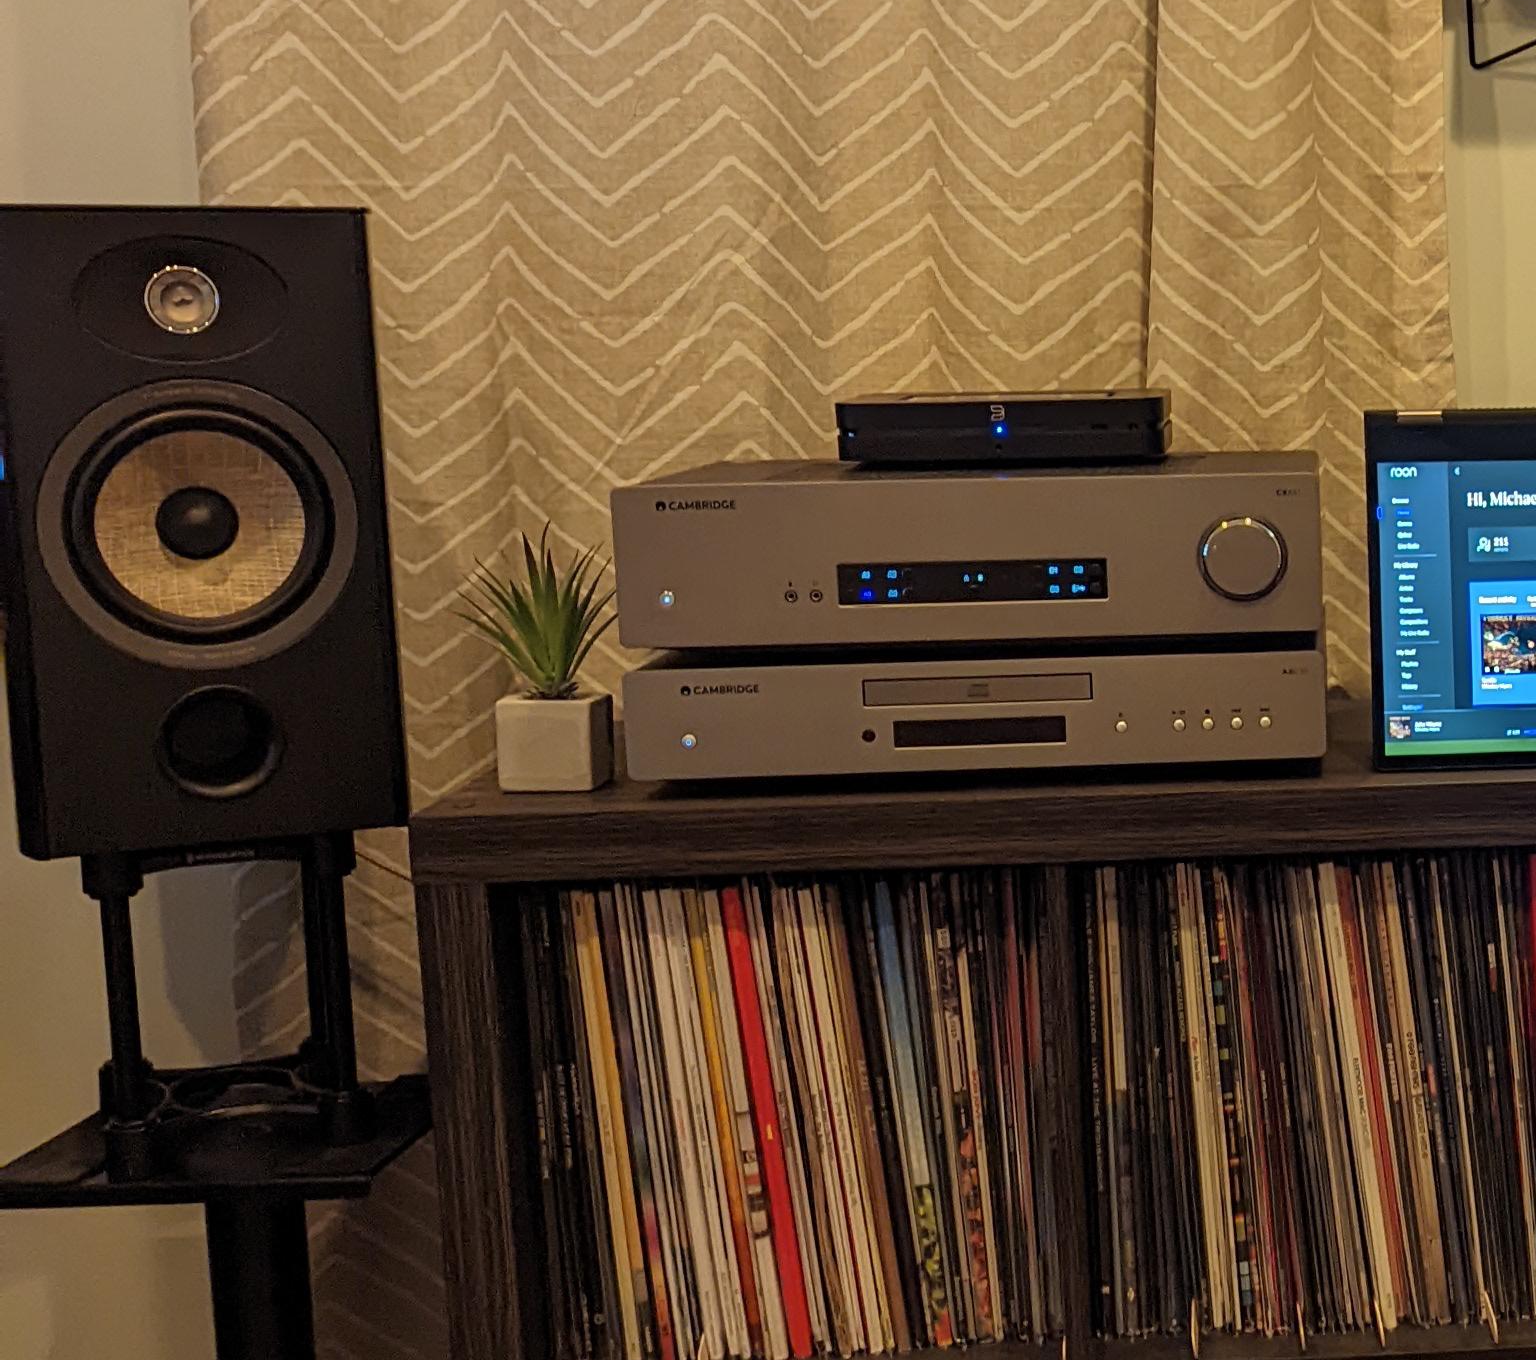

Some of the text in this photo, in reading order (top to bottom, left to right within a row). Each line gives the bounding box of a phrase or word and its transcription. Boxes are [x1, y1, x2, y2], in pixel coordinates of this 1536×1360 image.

[1390, 467, 1417, 478] roon
[669, 500, 736, 511] CAMBRIDGE
[1467, 492, 1487, 508] Hi,
[693, 684, 759, 695] CAMBRIDGE
